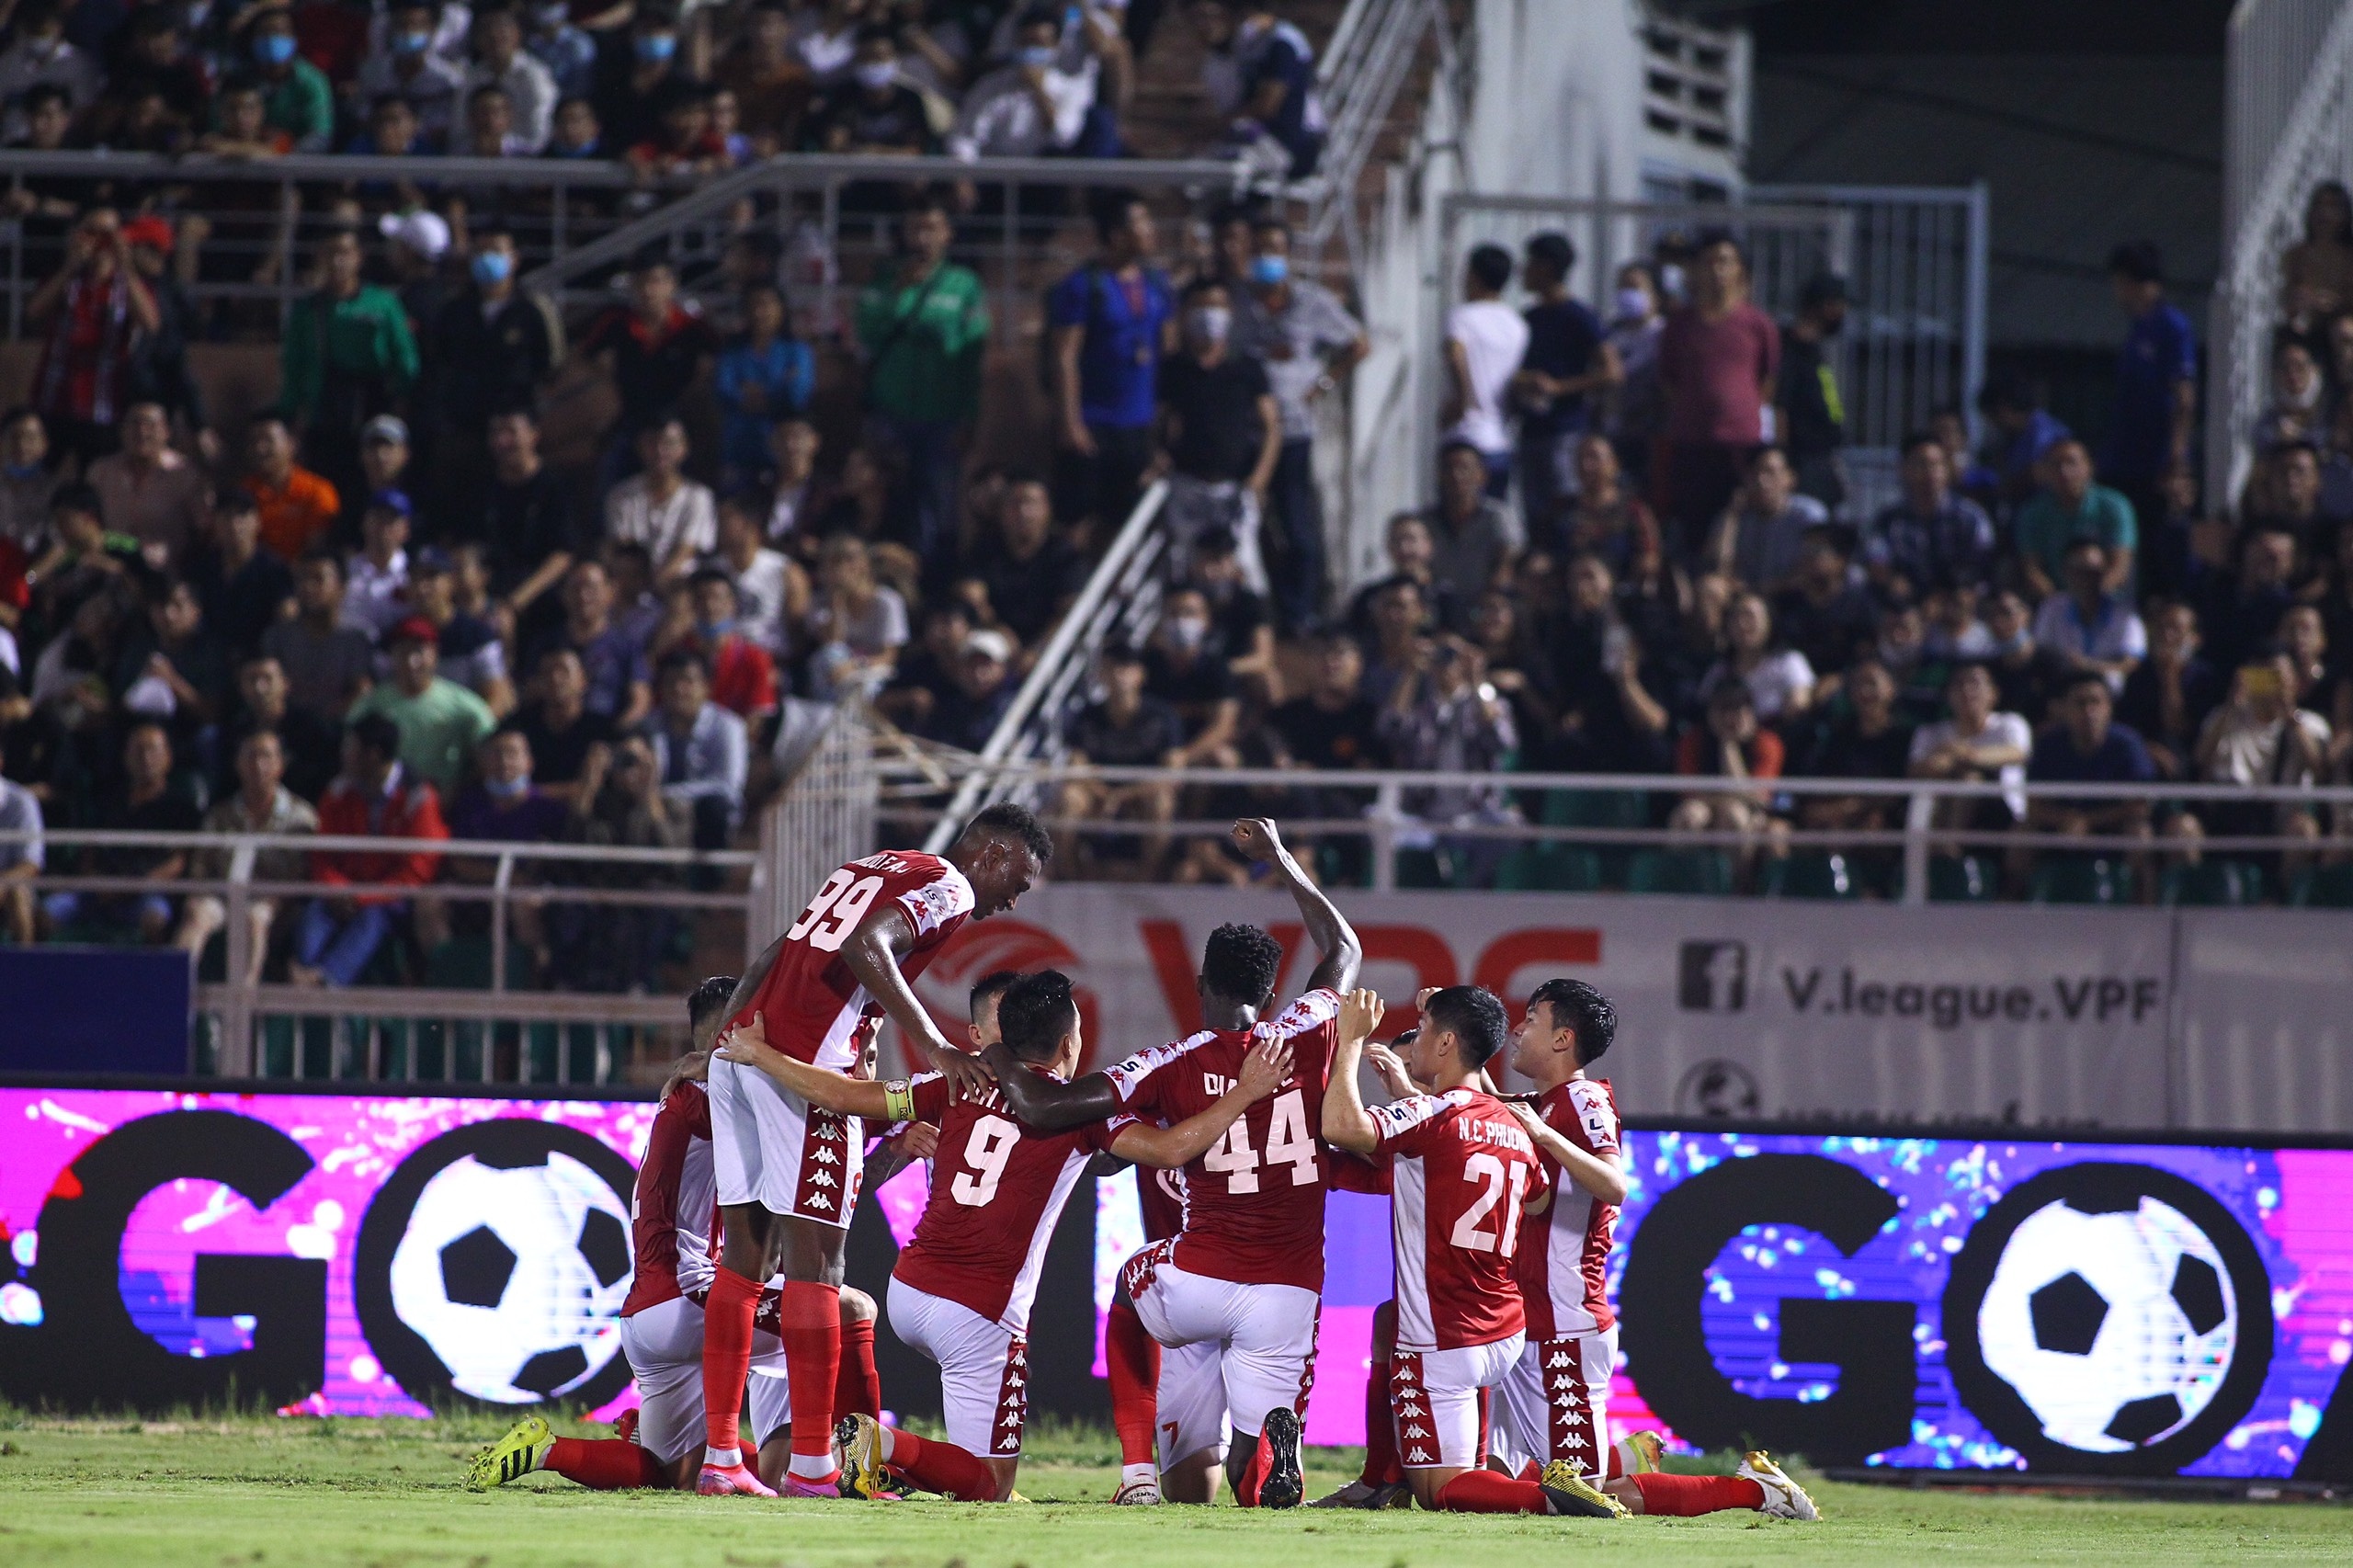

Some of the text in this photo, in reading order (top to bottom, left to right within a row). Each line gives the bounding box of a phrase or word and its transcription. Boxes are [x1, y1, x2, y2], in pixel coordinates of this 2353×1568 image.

[786, 868, 884, 952] 99
[1780, 964, 2160, 1031] V.league.VPF
[950, 1114, 1022, 1207] 9
[1203, 1088, 1319, 1194] 44
[1449, 1152, 1528, 1258] 21
[1620, 1153, 2353, 1479] GO
